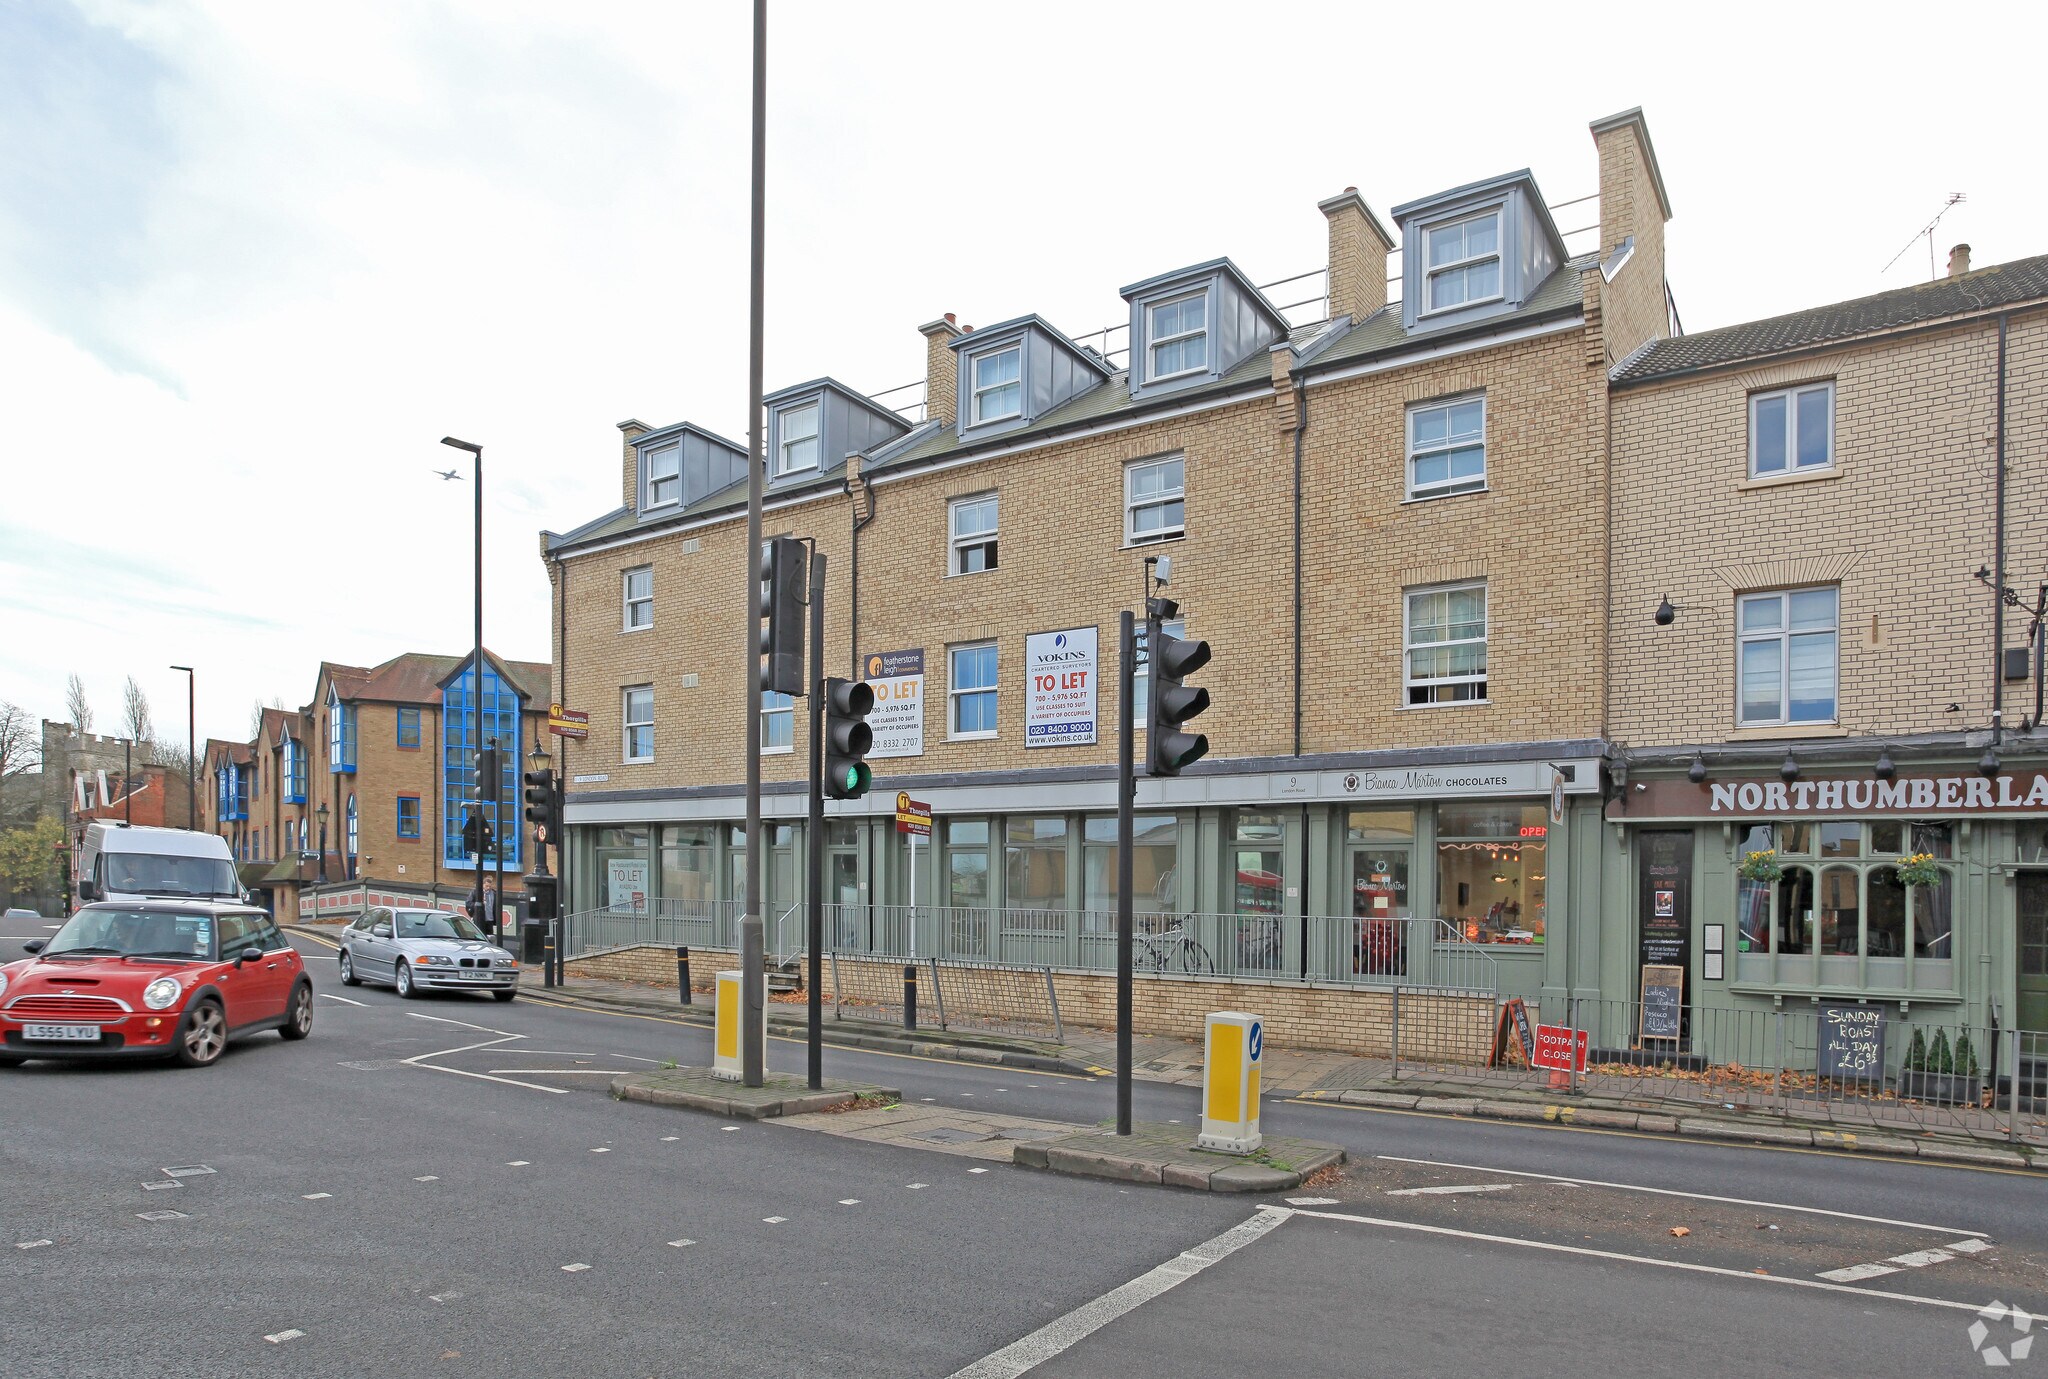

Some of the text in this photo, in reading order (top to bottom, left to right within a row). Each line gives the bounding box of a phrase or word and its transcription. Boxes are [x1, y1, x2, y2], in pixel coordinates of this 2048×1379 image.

[884, 656, 920, 666] featherstone
[1038, 650, 1086, 662] VOKINS
[884, 665, 898, 675] leigh
[1034, 672, 1087, 692] TO LET
[894, 681, 918, 699] LET
[1031, 723, 1091, 734] 020 8400 9000
[883, 739, 899, 748] 8332
[902, 738, 918, 746] 2707
[1028, 732, 1093, 744] www.vokins.co.uk
[1290, 777, 1296, 788] 9
[1365, 772, 1398, 790] Bianca
[1446, 777, 1507, 786] CHOCOLATES
[909, 807, 930, 816] Thorgills
[613, 870, 643, 881] TO LET
[1827, 1010, 1879, 1025] SUNDAY
[28, 1026, 94, 1038] LS55 LYU
[1840, 1025, 1879, 1038] ROAST
[1829, 1040, 1878, 1053] ALL DAY
